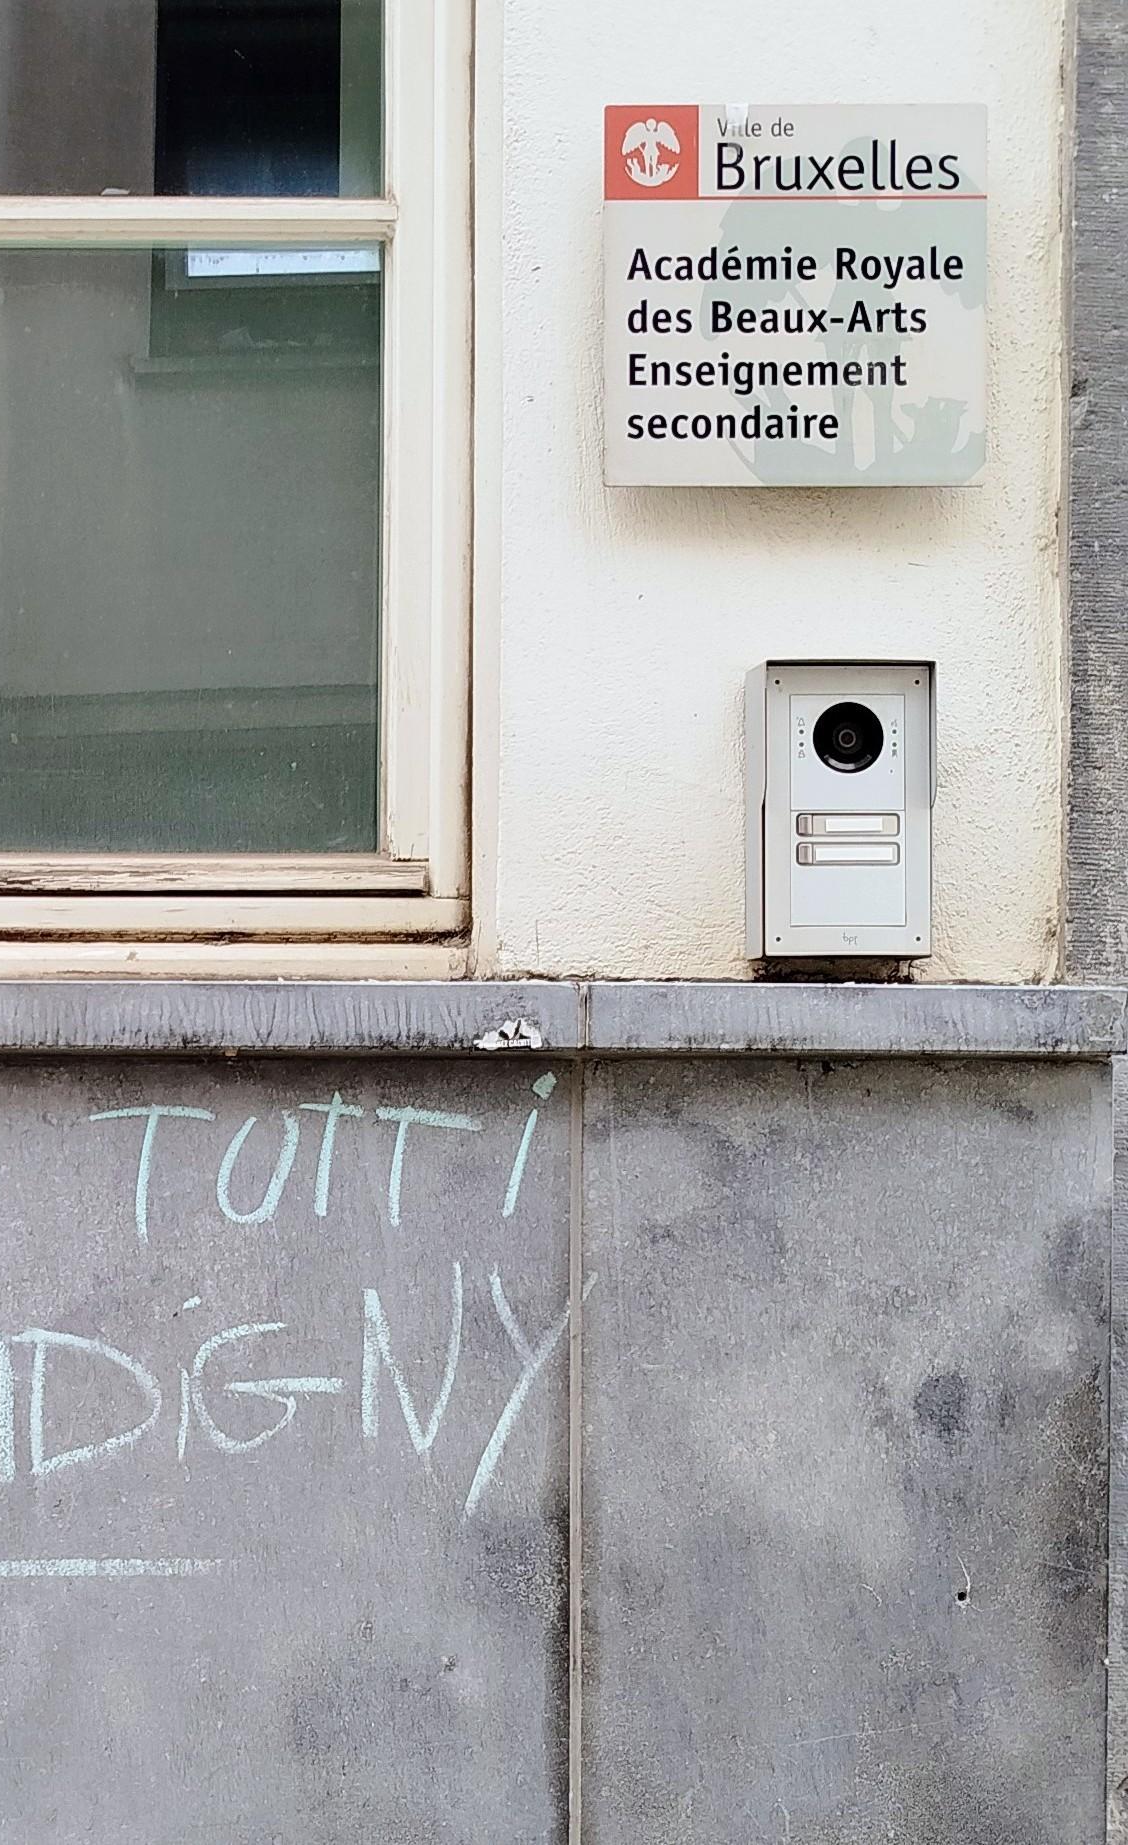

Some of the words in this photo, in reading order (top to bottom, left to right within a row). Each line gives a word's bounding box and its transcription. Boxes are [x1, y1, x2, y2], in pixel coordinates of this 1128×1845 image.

[771, 117, 794, 137] de
[716, 139, 960, 191] Bruxelles
[627, 246, 817, 281] Académie
[836, 246, 964, 290] Royale
[627, 300, 693, 334] des
[711, 301, 927, 334] Beaux-Arts
[629, 352, 907, 396] Enseignement
[627, 405, 839, 440] secondaire
